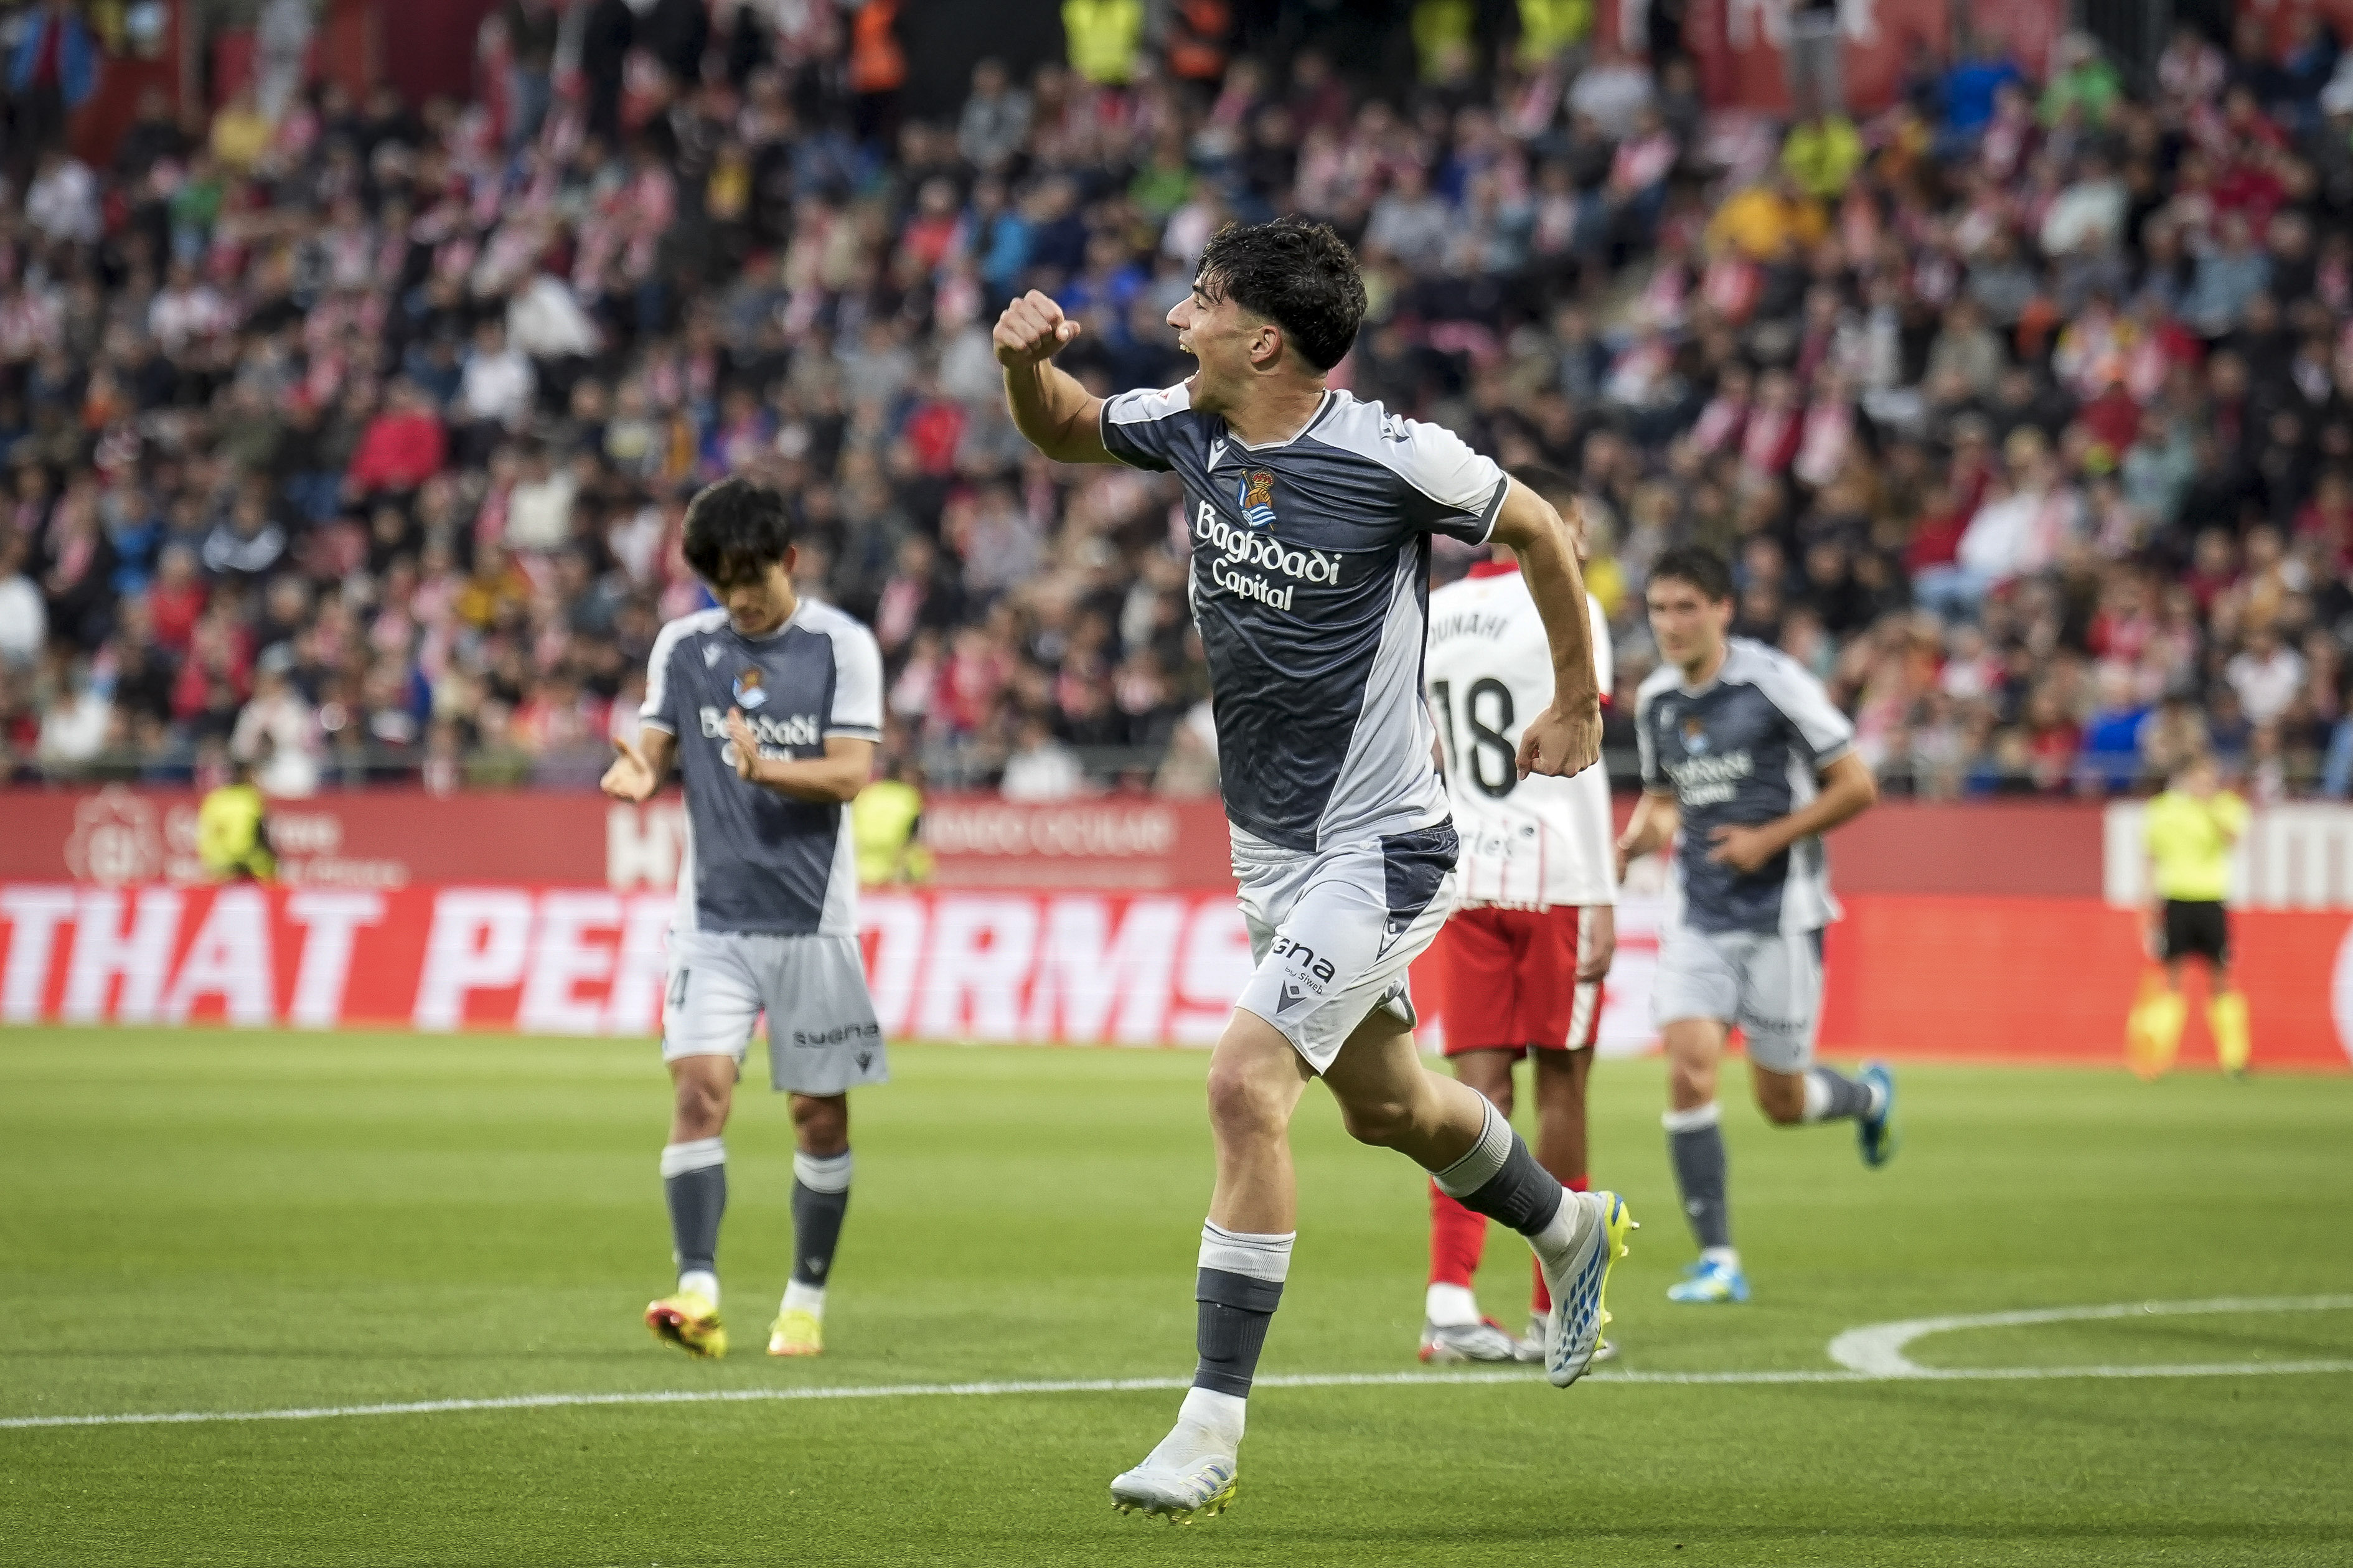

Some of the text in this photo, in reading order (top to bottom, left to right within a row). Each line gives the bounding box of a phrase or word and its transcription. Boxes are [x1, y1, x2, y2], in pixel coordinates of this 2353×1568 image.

[1196, 500, 1343, 586] Baghdadi
[1212, 558, 1294, 611] Capital
[1430, 677, 1518, 799] 18
[0, 888, 387, 1028] THAT
[1298, 972, 1323, 995] Siweb
